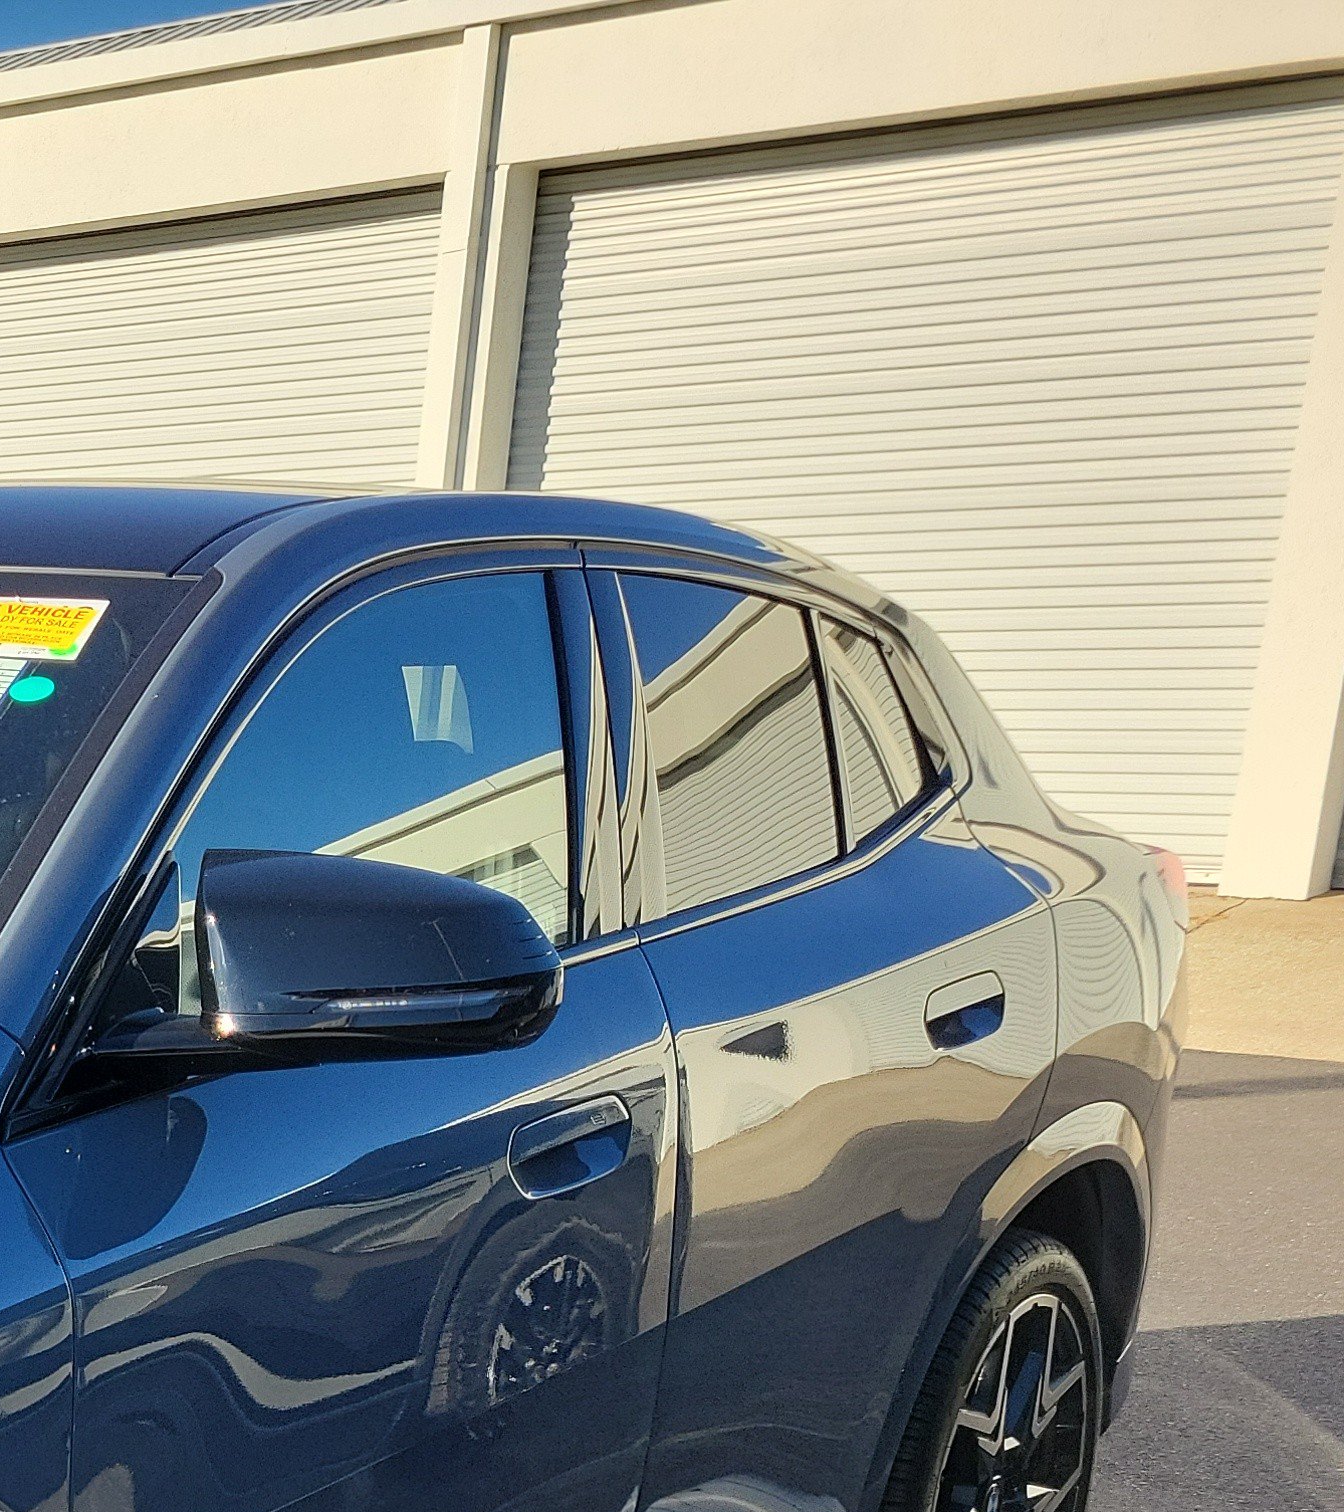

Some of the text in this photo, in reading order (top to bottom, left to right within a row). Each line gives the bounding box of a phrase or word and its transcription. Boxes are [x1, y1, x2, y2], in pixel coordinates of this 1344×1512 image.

[7, 604, 90, 620] VEHICLE
[18, 616, 44, 626] FOR
[45, 619, 80, 629] SALE
